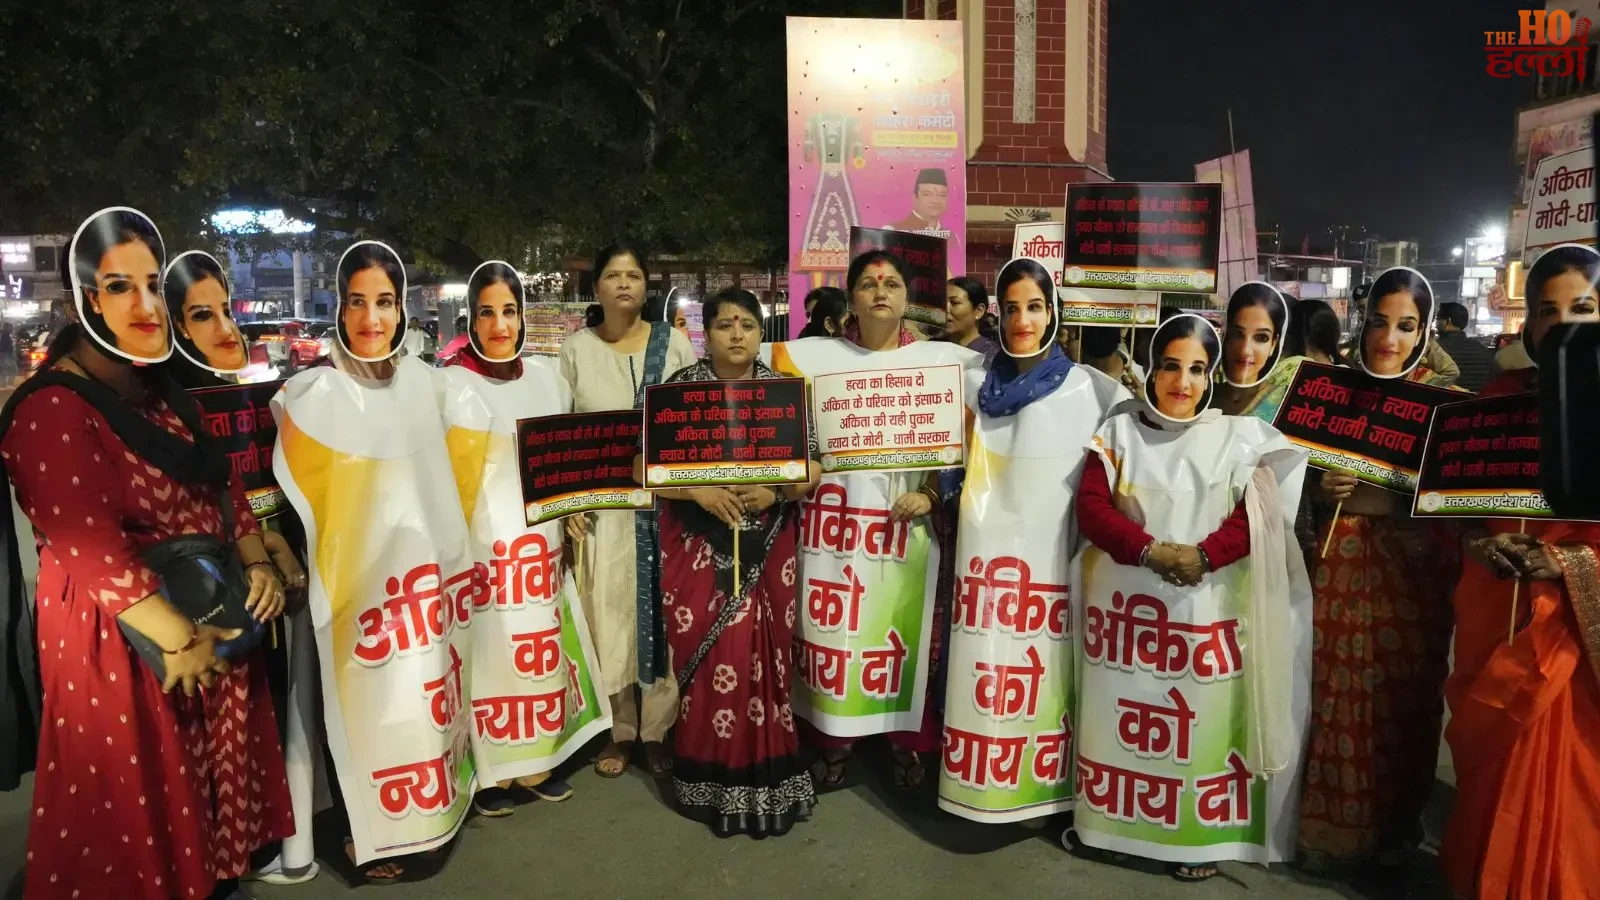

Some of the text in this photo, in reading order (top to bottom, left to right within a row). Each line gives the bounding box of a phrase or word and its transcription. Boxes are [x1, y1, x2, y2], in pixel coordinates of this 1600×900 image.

[918, 110, 955, 128] कमेटी
[1539, 166, 1596, 197] अंकिता
[1021, 235, 1063, 258] अंकिता
[1085, 271, 1118, 283] उत्तराखण्ड
[1120, 270, 1136, 284] प्रदेश
[1136, 270, 1162, 284] महिला
[1082, 305, 1106, 318] महिला
[846, 372, 924, 392] हत्या का हिसाब दो
[682, 391, 704, 404] हत्या
[708, 390, 722, 402] का
[756, 386, 765, 400] दो
[822, 388, 954, 413] अंकिता के परिवार को इंसाफ दो
[1298, 376, 1352, 406] अंकिता
[1382, 396, 1430, 424] न्याय
[234, 400, 256, 434] को
[654, 404, 796, 424] अंकिता के परिवार को इंसाफ दो
[840, 410, 935, 430] अंकिता की यही पुकार
[675, 426, 708, 442] अंकिता
[712, 424, 725, 439] की
[750, 427, 776, 442] पुकार
[1288, 402, 1368, 440] मोदी-धामी
[1368, 425, 1417, 454] जवाब
[828, 436, 848, 448] न्याय
[852, 432, 860, 447] दो
[863, 432, 883, 446] मोदी
[894, 430, 914, 444] धामी
[918, 431, 950, 444] सरकार
[660, 450, 686, 461] न्याय
[688, 445, 698, 460] दो
[701, 445, 722, 460] मोदी
[732, 445, 756, 459] धामी
[758, 446, 792, 458] सरकार
[836, 454, 869, 466] उत्तराखण्ड
[870, 452, 890, 465] प्रदेश
[890, 450, 914, 464] महिला
[670, 466, 780, 480] उत्तराखण्ड प्रदेश महिला कांग्रेस
[1330, 454, 1350, 468] प्रदेश
[1350, 460, 1380, 478] महिला
[1486, 462, 1520, 476] सरकार
[1444, 496, 1492, 508] उत्तराखण्ड
[1493, 492, 1519, 510] प्रदेश
[808, 564, 865, 632] को
[1084, 590, 1243, 678] अंकिता
[861, 630, 906, 695] दो
[976, 645, 1045, 717] को
[1118, 686, 1195, 760] को
[1034, 712, 1072, 781] दो
[1197, 752, 1252, 822] दो
